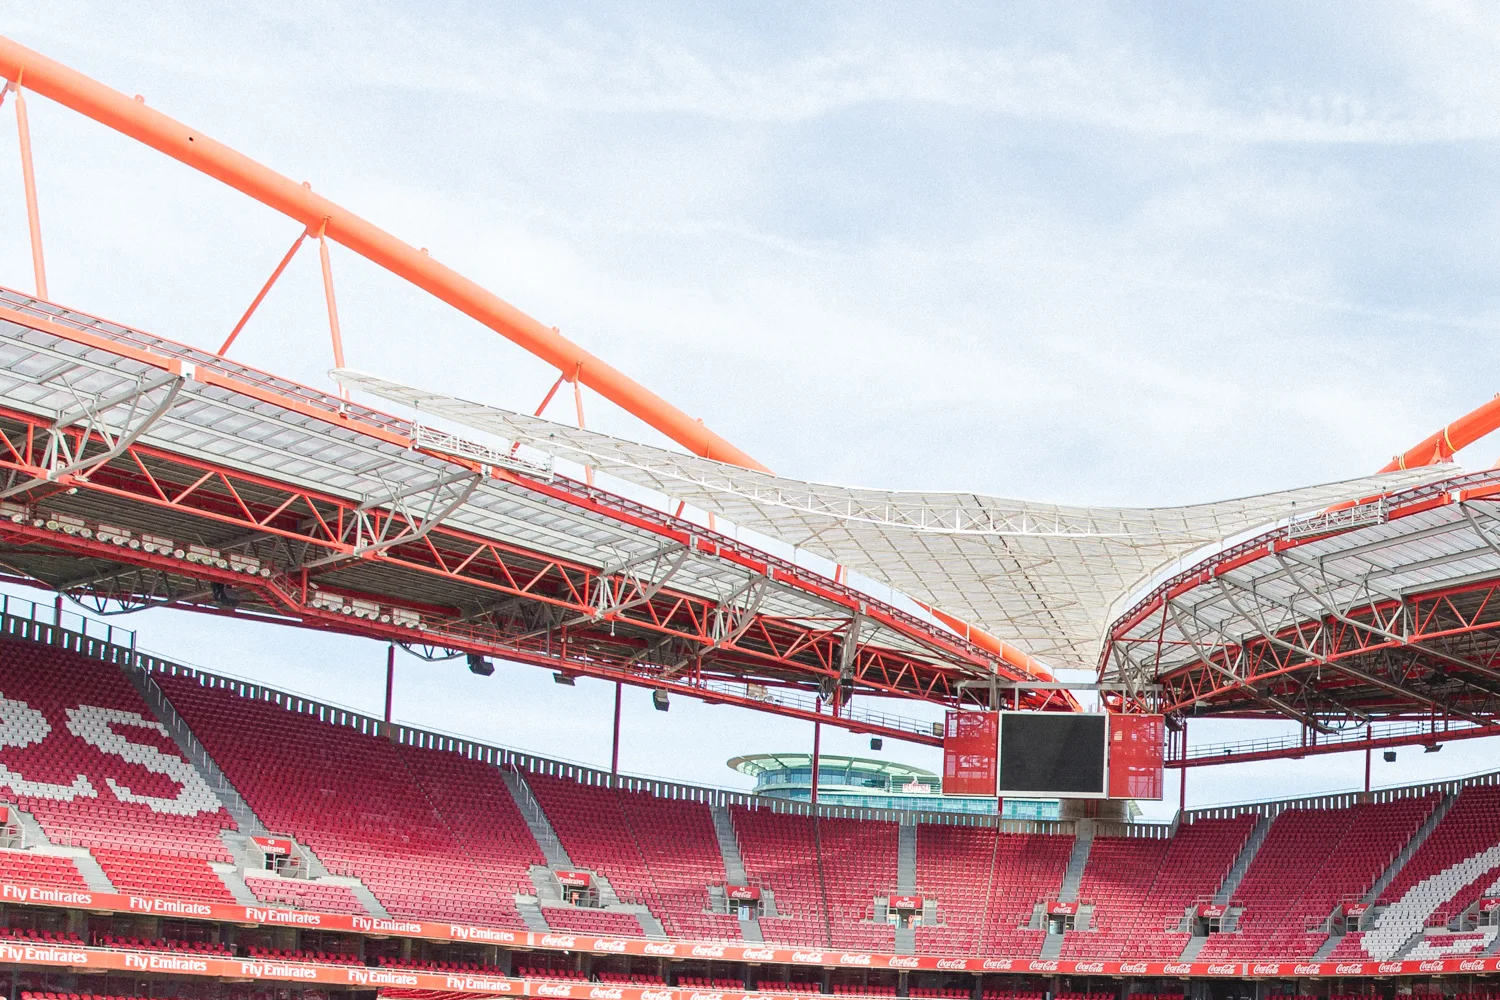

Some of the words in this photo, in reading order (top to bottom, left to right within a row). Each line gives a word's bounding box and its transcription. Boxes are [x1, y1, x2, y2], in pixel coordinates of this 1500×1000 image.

[259, 845, 285, 853] mirates
[3, 884, 27, 900] Fly
[30, 887, 91, 904] Emirates
[130, 897, 152, 911] Fly
[154, 900, 210, 914] Emirates
[246, 907, 266, 922] Fly
[268, 910, 320, 925] Emirates
[352, 916, 371, 930] Fly
[373, 919, 421, 933] Emirates
[450, 924, 468, 939] Fly
[469, 927, 514, 941] Emirates
[0, 945, 22, 961] Fly
[25, 948, 87, 963] Emirates
[125, 954, 148, 969] Fly
[150, 956, 207, 971] Emirates
[241, 963, 262, 976] Fly
[264, 964, 316, 979] Emirates
[348, 970, 368, 984] Fly
[369, 972, 417, 985] Emirates
[446, 977, 464, 990] Fly
[466, 978, 511, 991] Emirates
